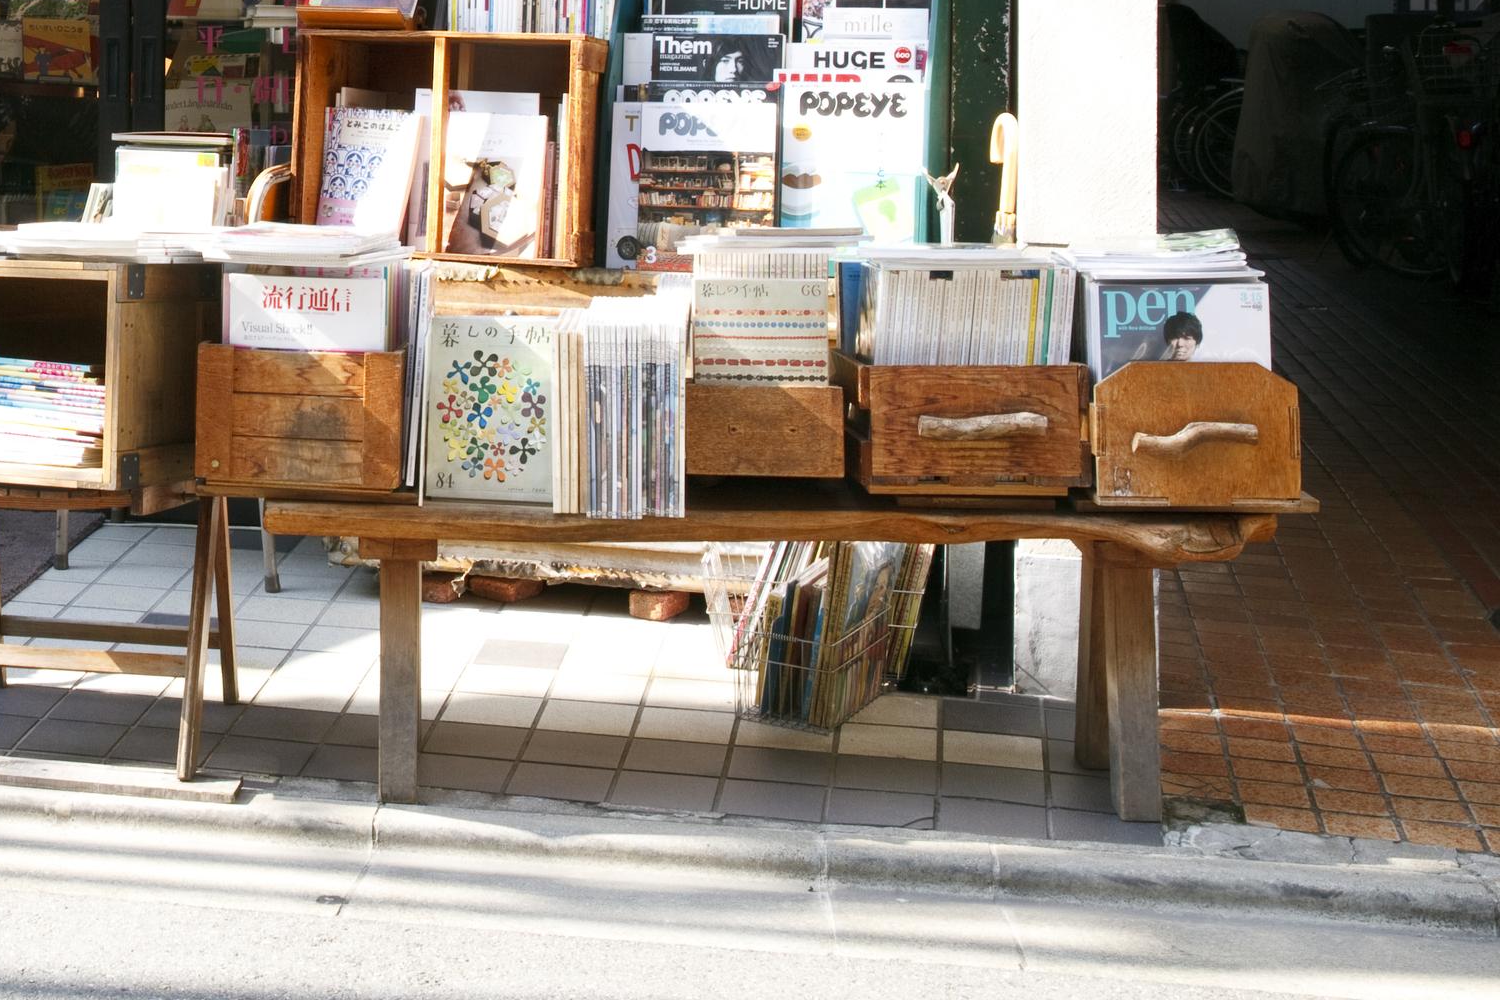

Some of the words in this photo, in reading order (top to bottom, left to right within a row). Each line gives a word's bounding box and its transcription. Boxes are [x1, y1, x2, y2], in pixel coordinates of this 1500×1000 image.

[844, 14, 893, 32] mille
[655, 36, 712, 54] Them
[659, 53, 693, 61] magazine
[813, 51, 886, 69] HUGE
[895, 51, 912, 59] 600
[800, 91, 908, 118] POPEYE
[645, 246, 657, 264] 3
[261, 284, 352, 312] 流行通信
[701, 282, 769, 298] 暮しの手帖
[801, 284, 822, 297] 66
[1102, 289, 1196, 338] pen
[241, 321, 273, 334] Visual
[275, 322, 313, 335] Shock!!
[440, 322, 552, 348] 暮しの手帖
[435, 472, 455, 489] 84
